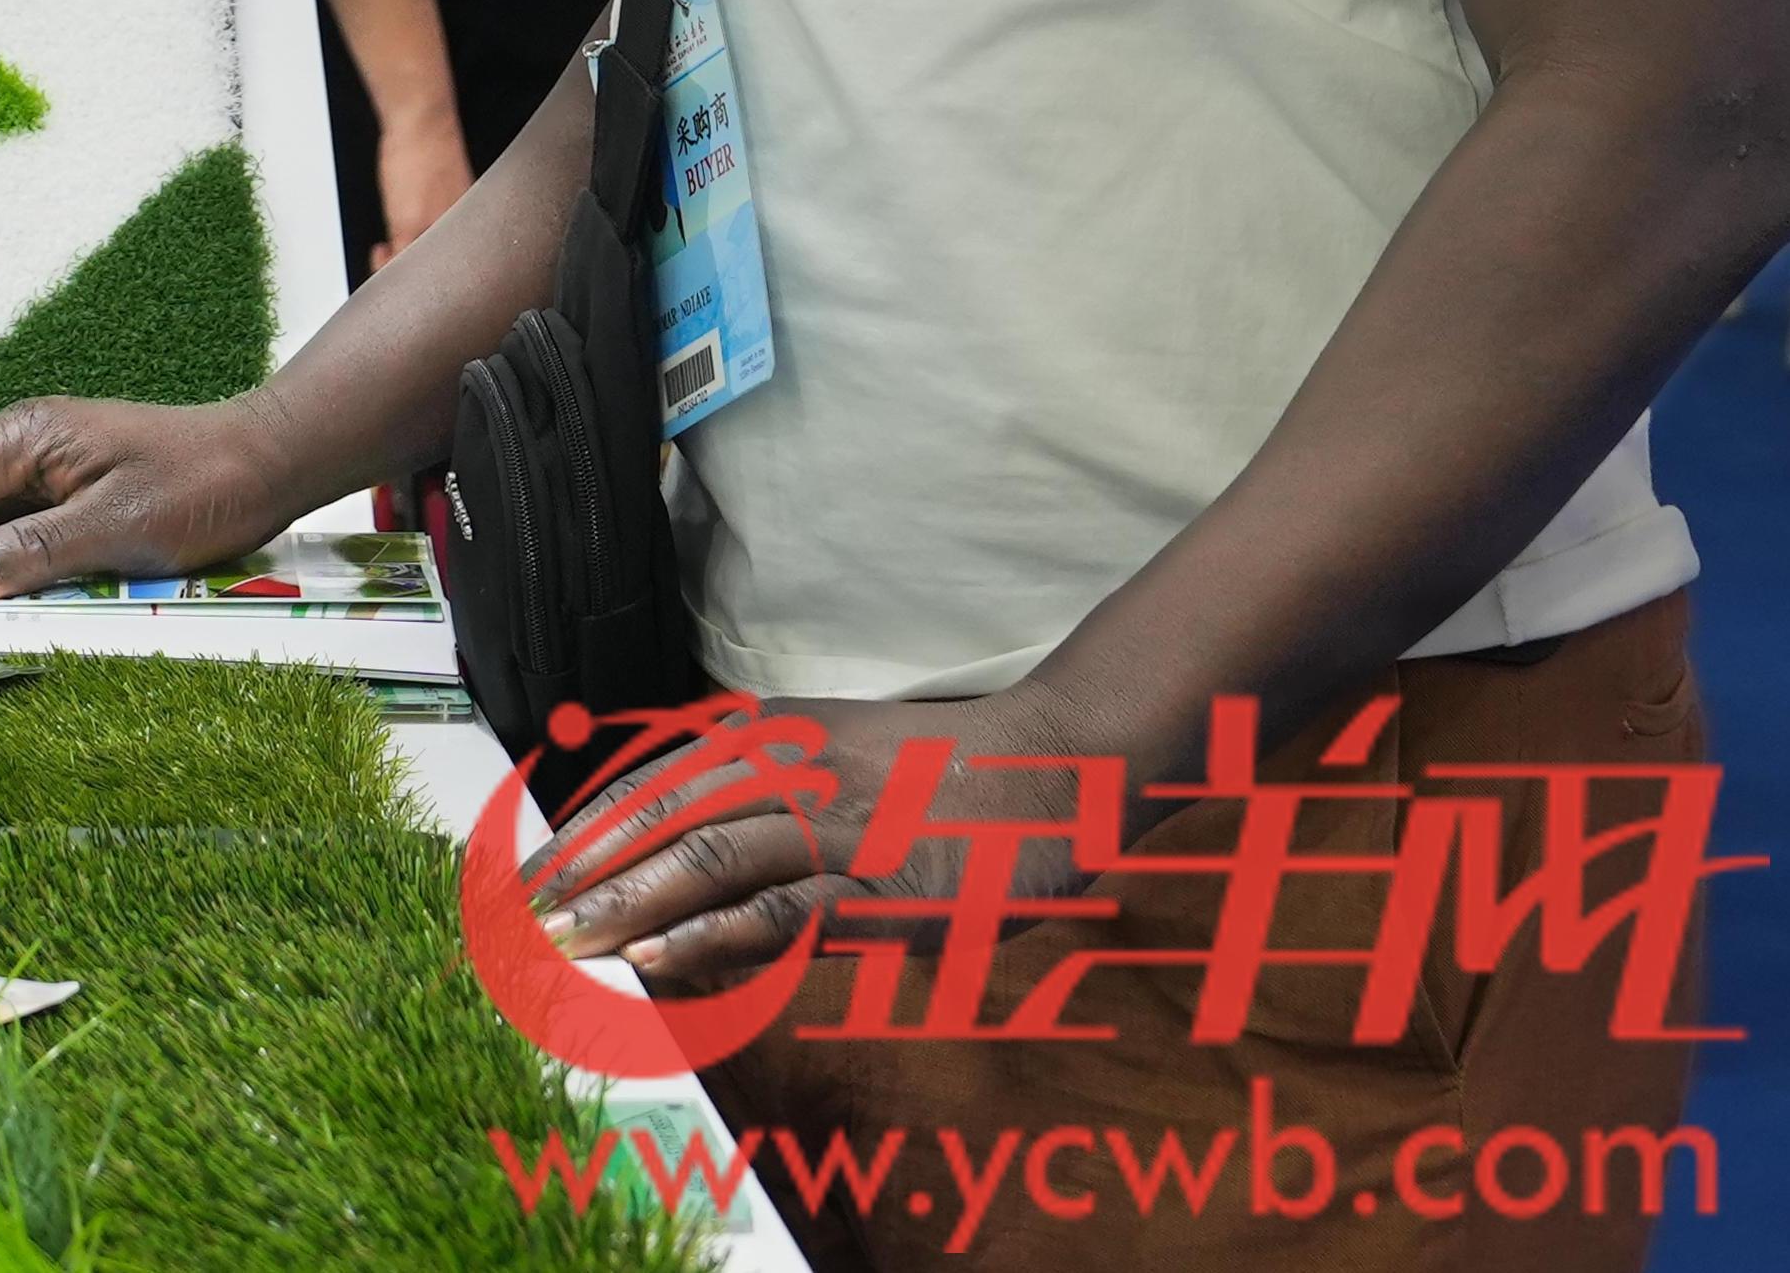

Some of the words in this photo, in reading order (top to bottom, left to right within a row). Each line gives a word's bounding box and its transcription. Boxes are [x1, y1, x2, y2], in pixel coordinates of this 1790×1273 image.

[676, 91, 729, 157] 采购商
[684, 142, 736, 198] BUYER
